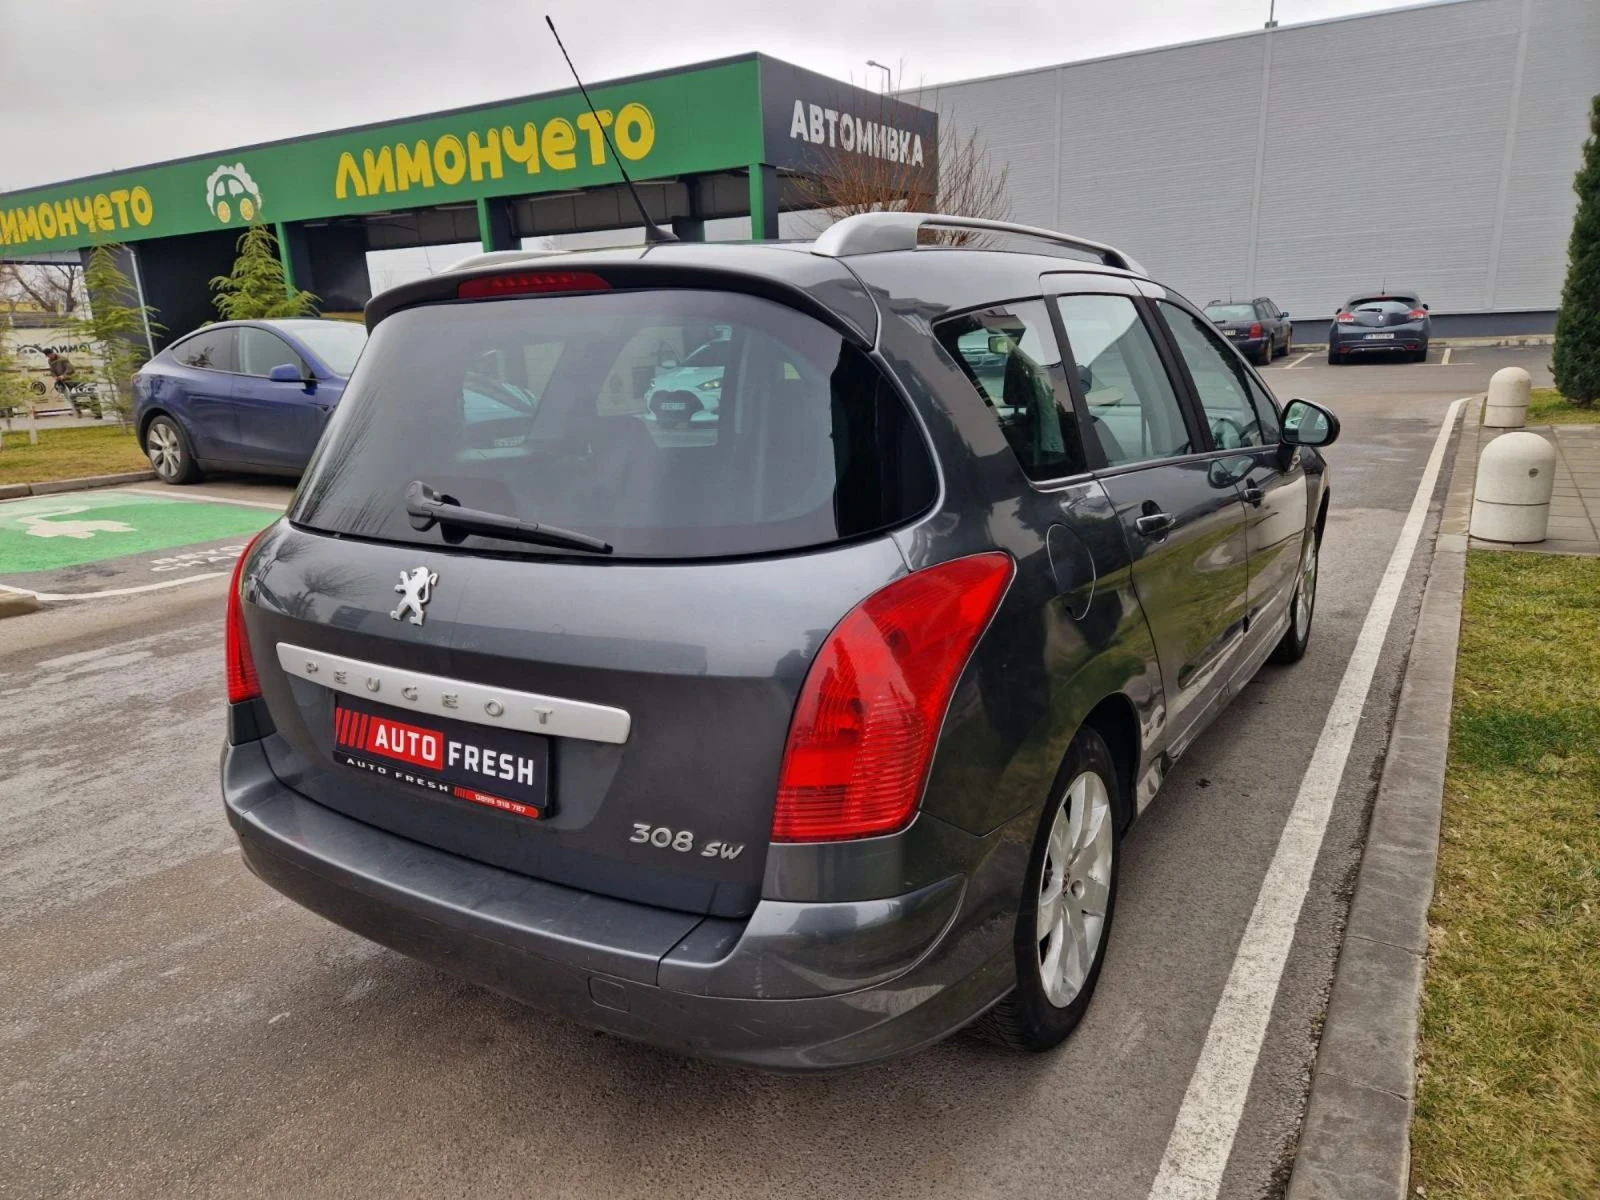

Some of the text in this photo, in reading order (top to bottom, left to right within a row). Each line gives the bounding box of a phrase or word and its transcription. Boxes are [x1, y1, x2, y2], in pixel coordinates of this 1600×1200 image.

[789, 99, 925, 168] АВТОМИВКА
[305, 659, 553, 725] PEUGEOT
[346, 757, 450, 792] AUTO FRESH
[374, 724, 533, 785] AUTO FRESH
[629, 823, 745, 860] 308 SW
